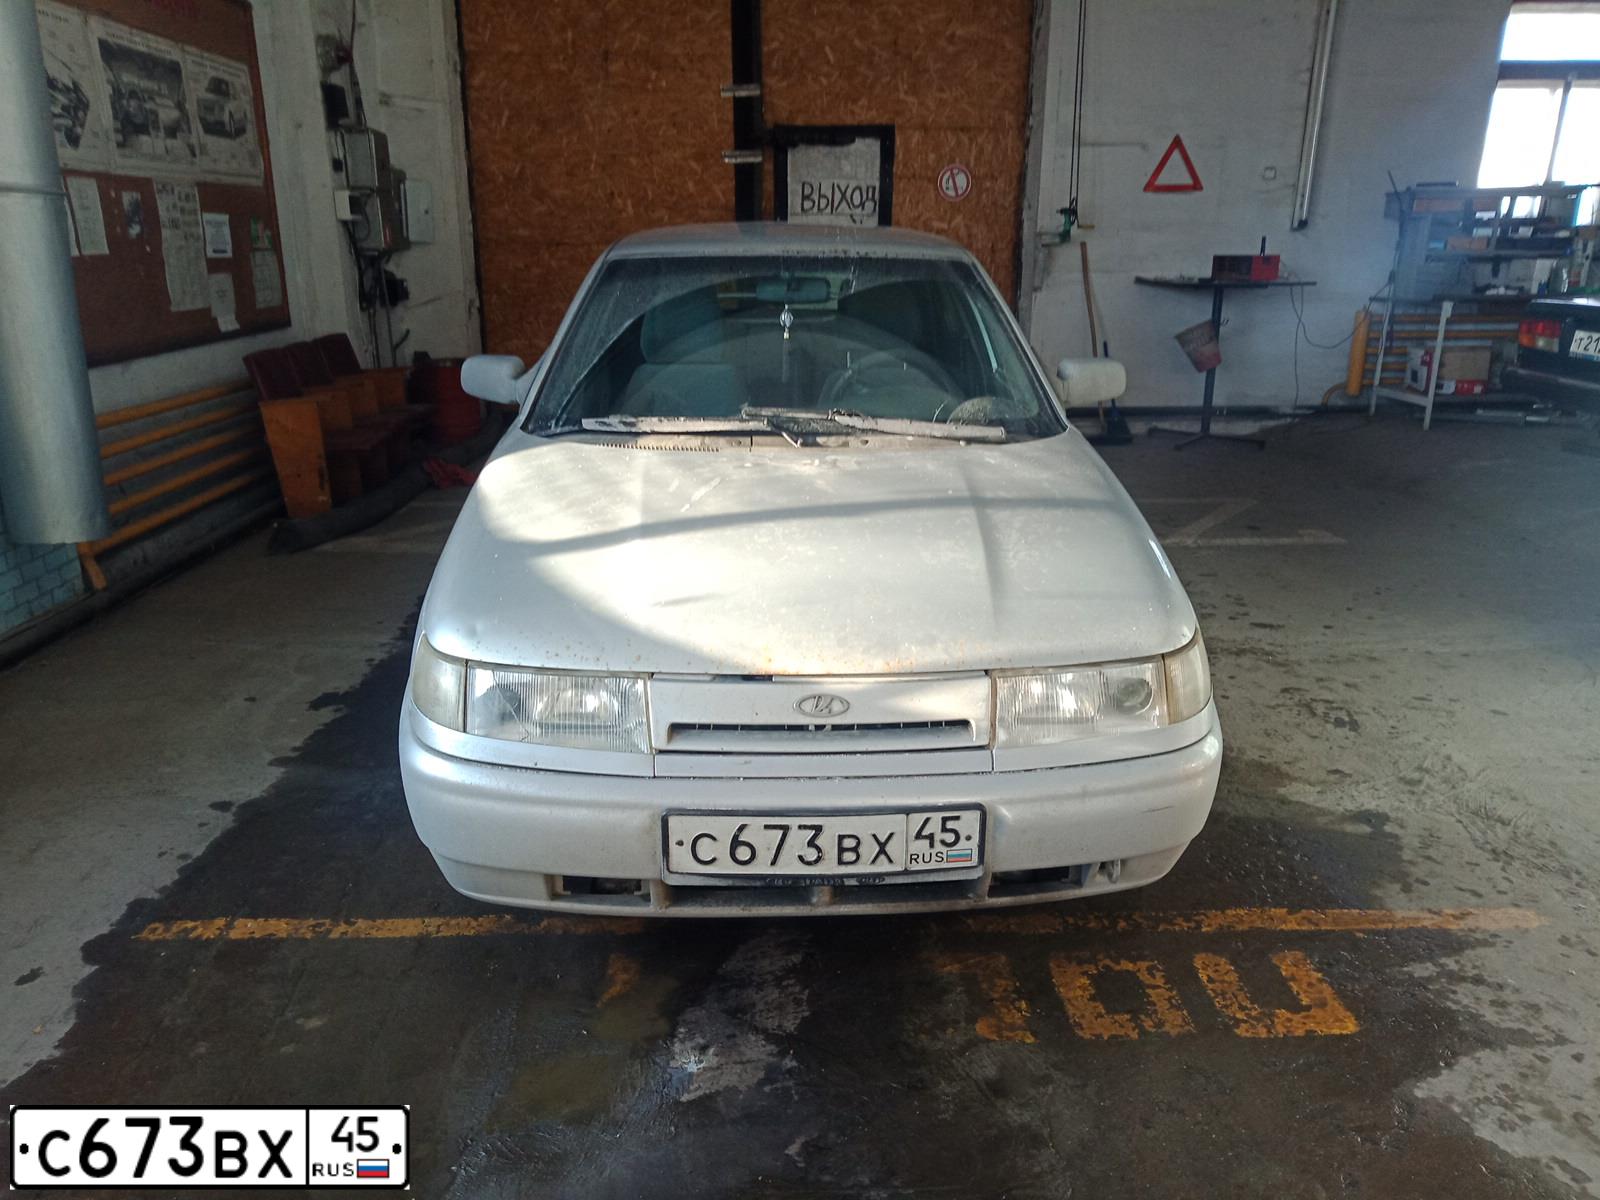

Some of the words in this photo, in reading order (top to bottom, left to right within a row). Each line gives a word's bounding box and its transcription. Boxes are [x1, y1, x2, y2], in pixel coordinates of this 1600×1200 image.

[801, 181, 877, 215] ВЫХОД
[690, 824, 895, 867] С673ВХ
[914, 815, 961, 849] 45
[909, 851, 945, 865] RUS
